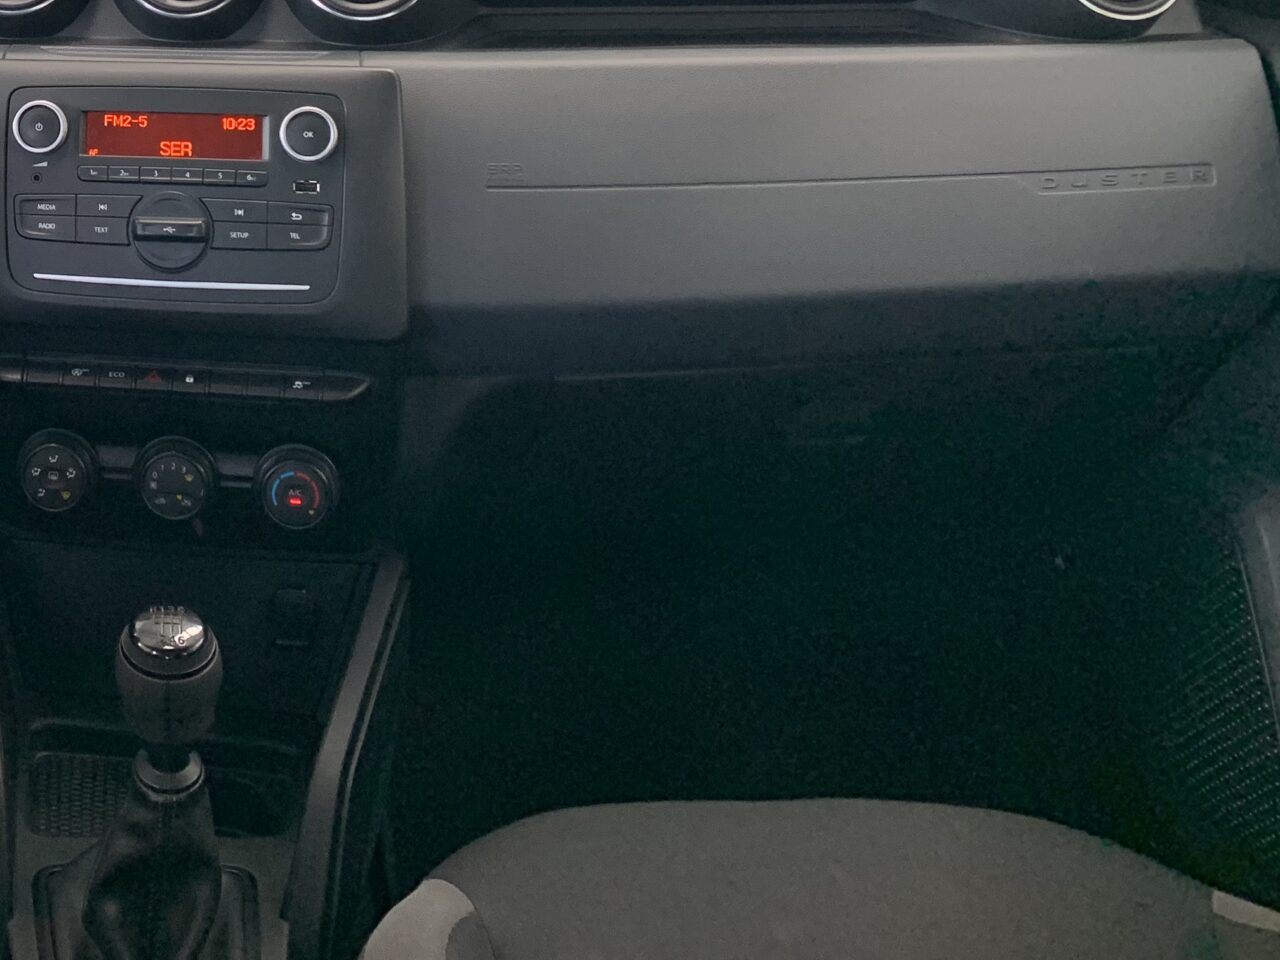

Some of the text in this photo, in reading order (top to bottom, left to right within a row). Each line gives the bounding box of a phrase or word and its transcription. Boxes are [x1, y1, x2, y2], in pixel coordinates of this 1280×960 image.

[103, 114, 257, 131] FM2-5 10:23
[159, 140, 193, 157] SER
[1041, 170, 1209, 190] DUSTER
[37, 203, 56, 211] MEDIA
[38, 222, 56, 230] RADIO
[94, 226, 109, 234] TEXT
[229, 231, 249, 239] SETUP
[288, 489, 301, 497] A/C
